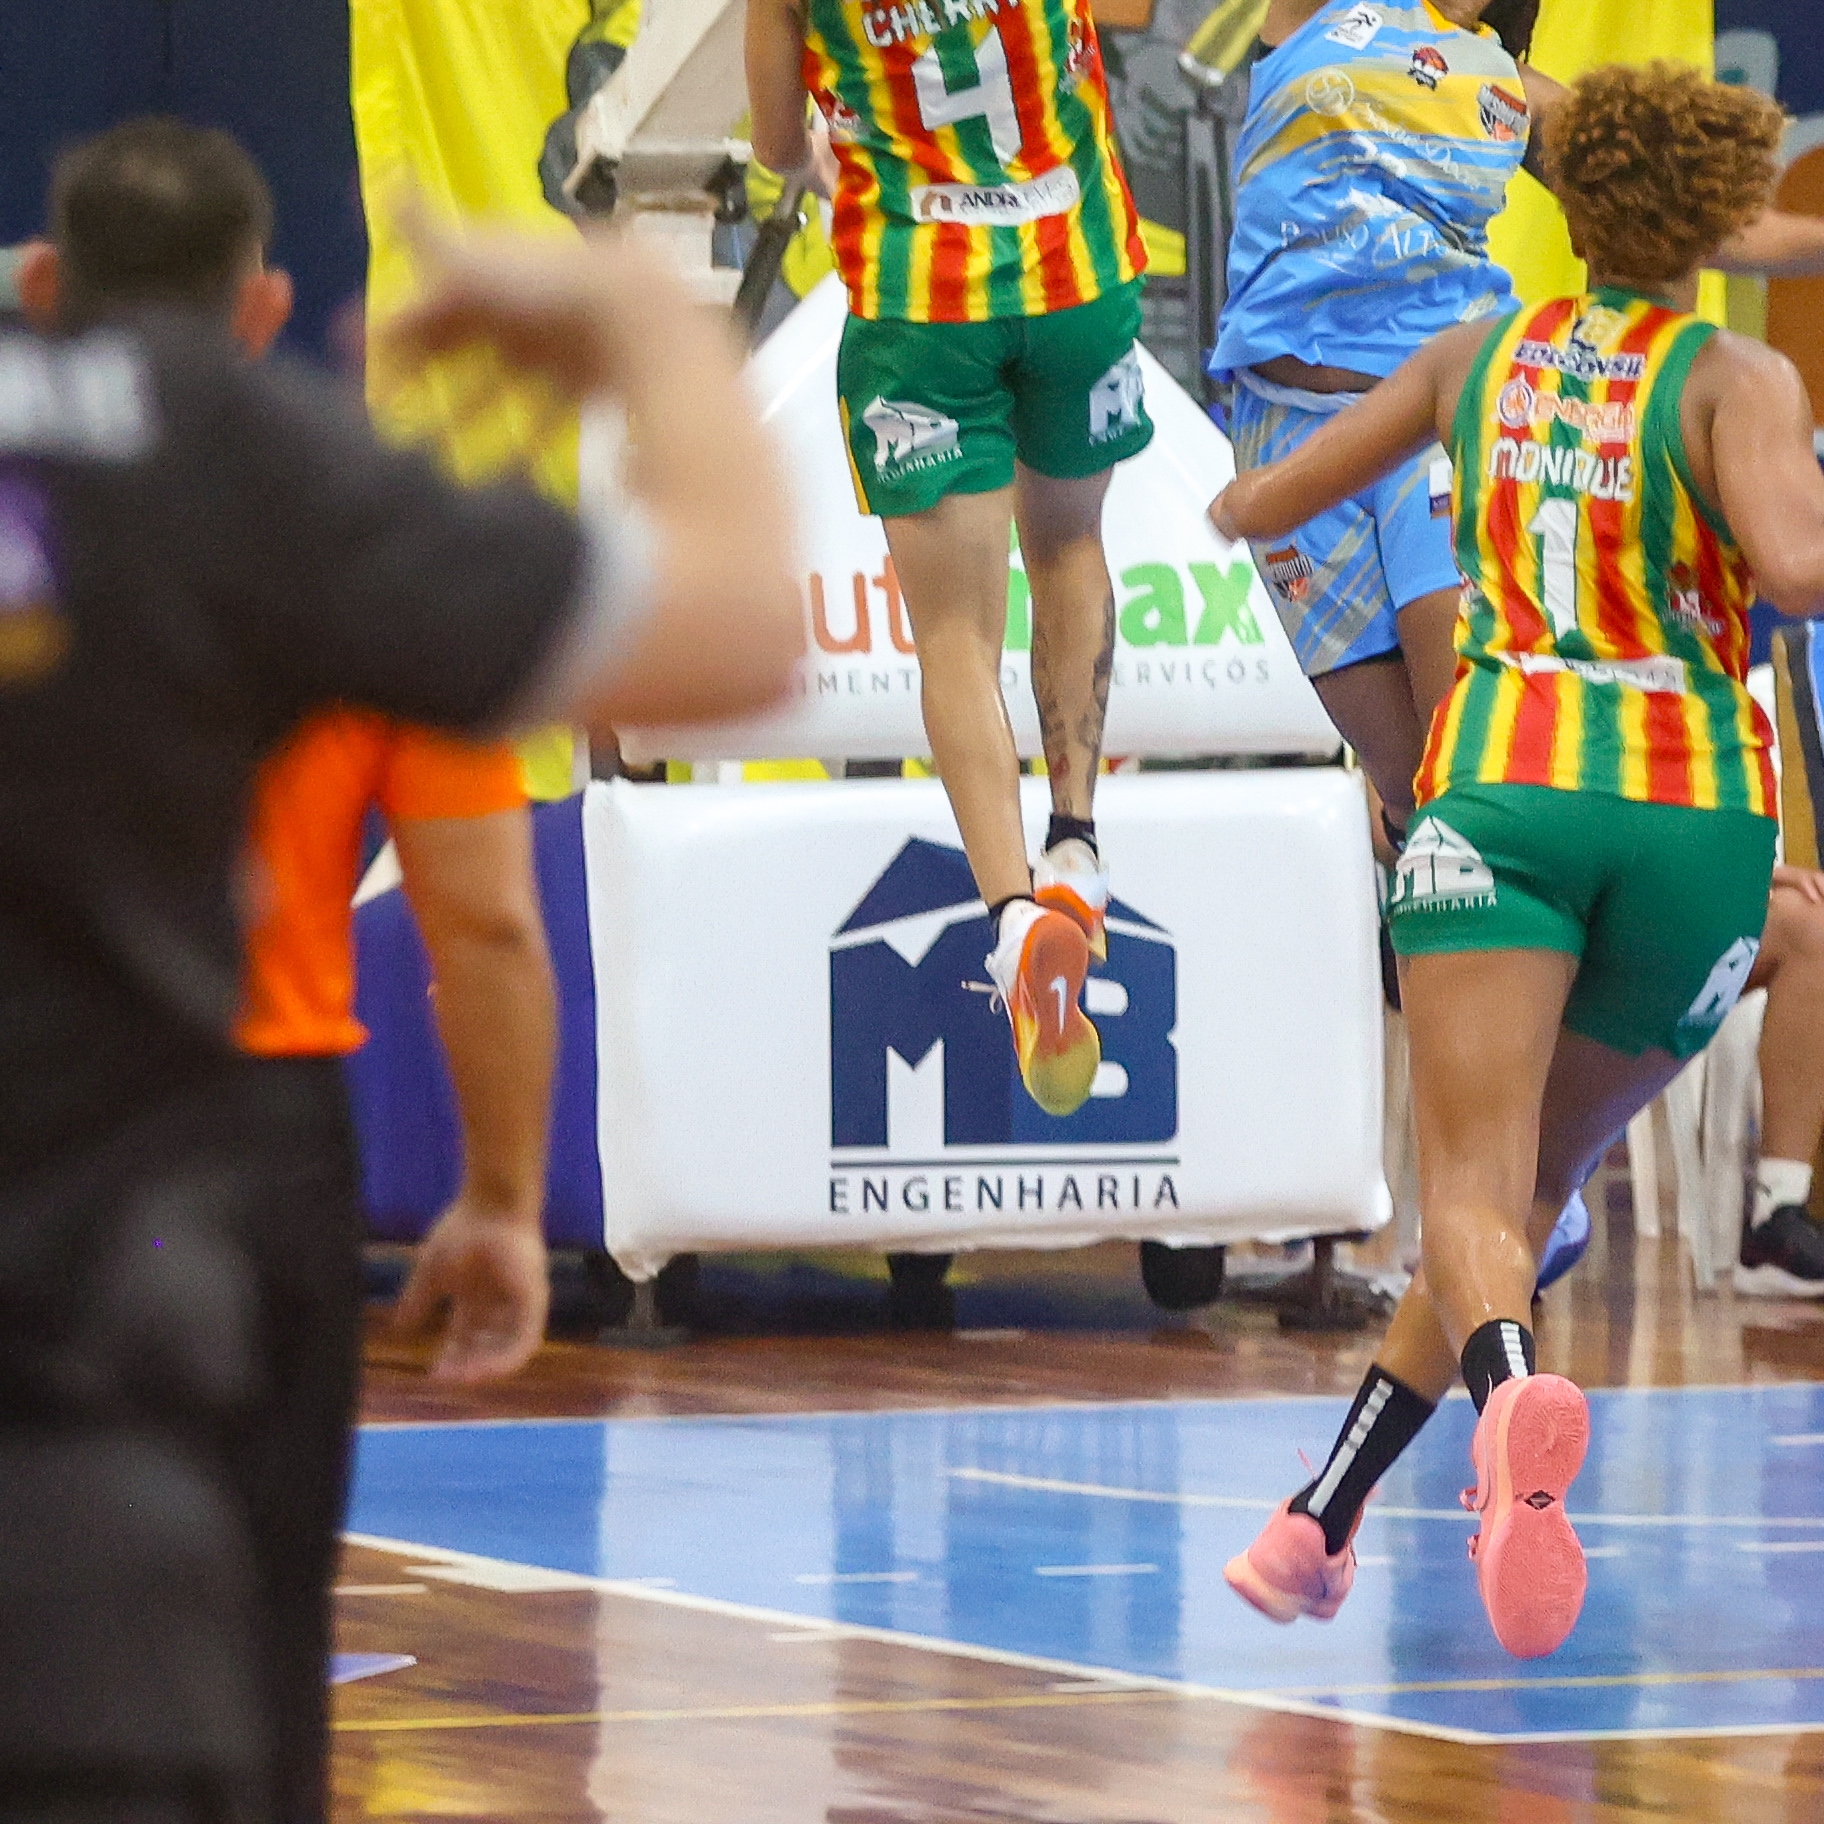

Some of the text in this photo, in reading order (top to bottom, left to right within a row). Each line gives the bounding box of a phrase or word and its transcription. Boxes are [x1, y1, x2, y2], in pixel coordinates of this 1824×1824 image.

[910, 24, 1023, 172] 4
[1489, 435, 1635, 502] MONIQUE
[1528, 497, 1578, 640] 1
[829, 1173, 1181, 1213] ENGENHARIA
